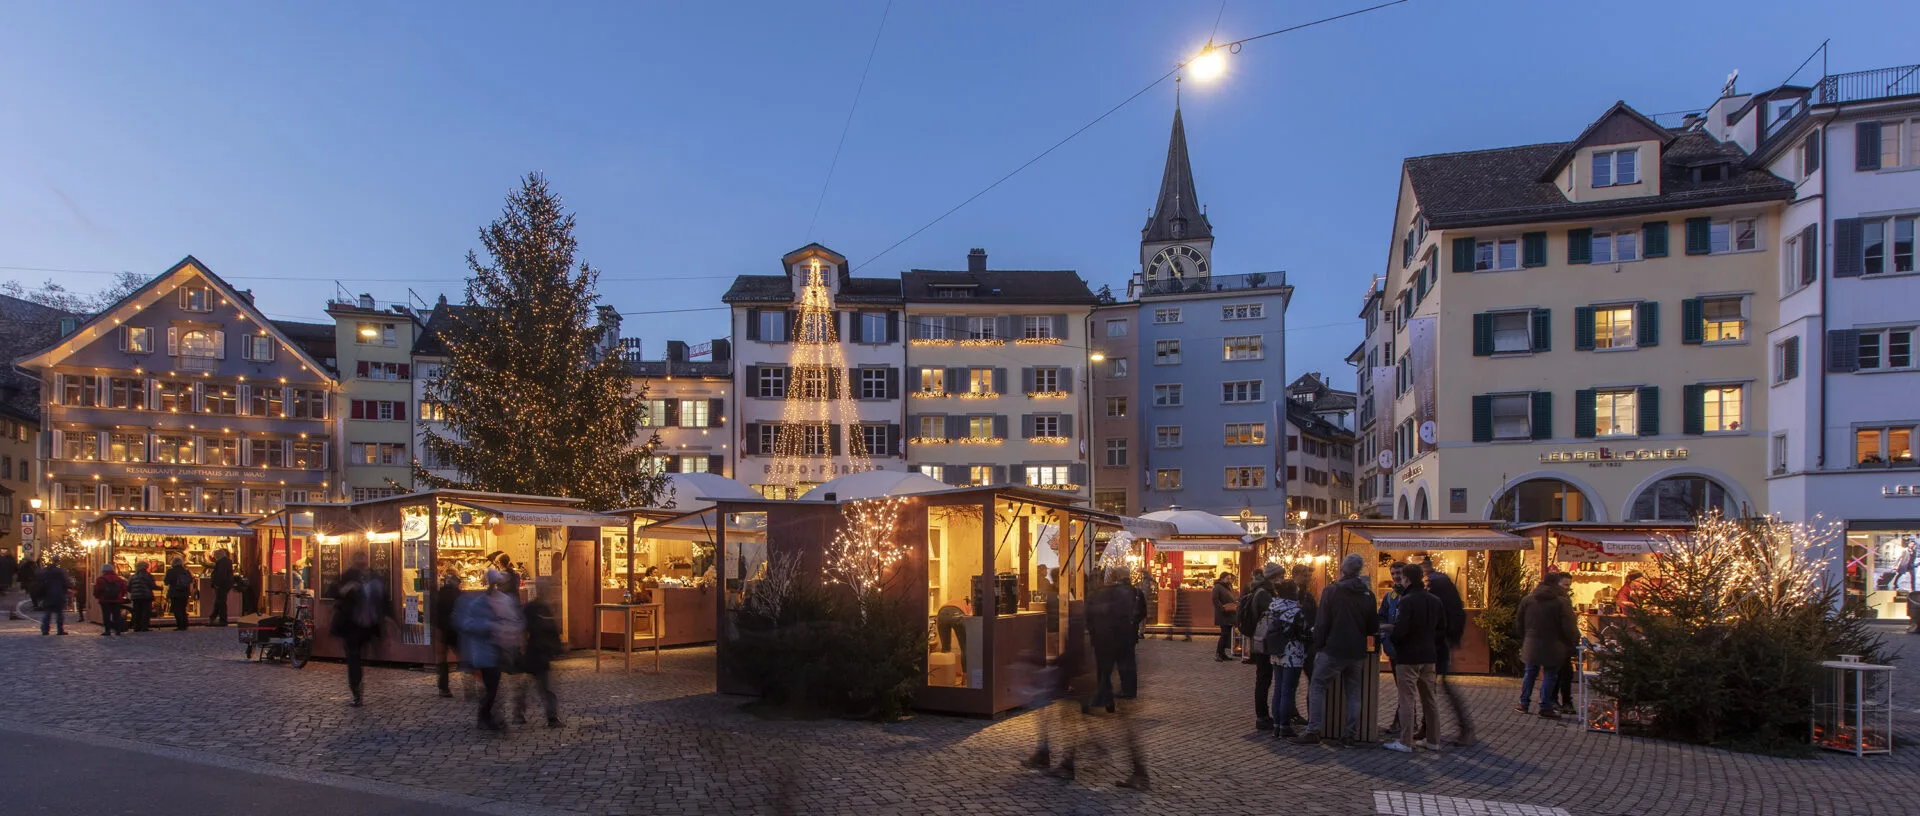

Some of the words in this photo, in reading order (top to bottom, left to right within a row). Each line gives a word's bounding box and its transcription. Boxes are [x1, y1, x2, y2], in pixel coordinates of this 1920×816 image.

[1540, 451, 1597, 461] LEDER
[1614, 448, 1689, 460] LOCHER
[125, 467, 173, 475] RESTAURANT
[178, 469, 222, 477] ZUNFTHAUS
[1376, 540, 1421, 548] Information
[1428, 540, 1453, 548] Zürich
[1606, 542, 1642, 551] Churros
